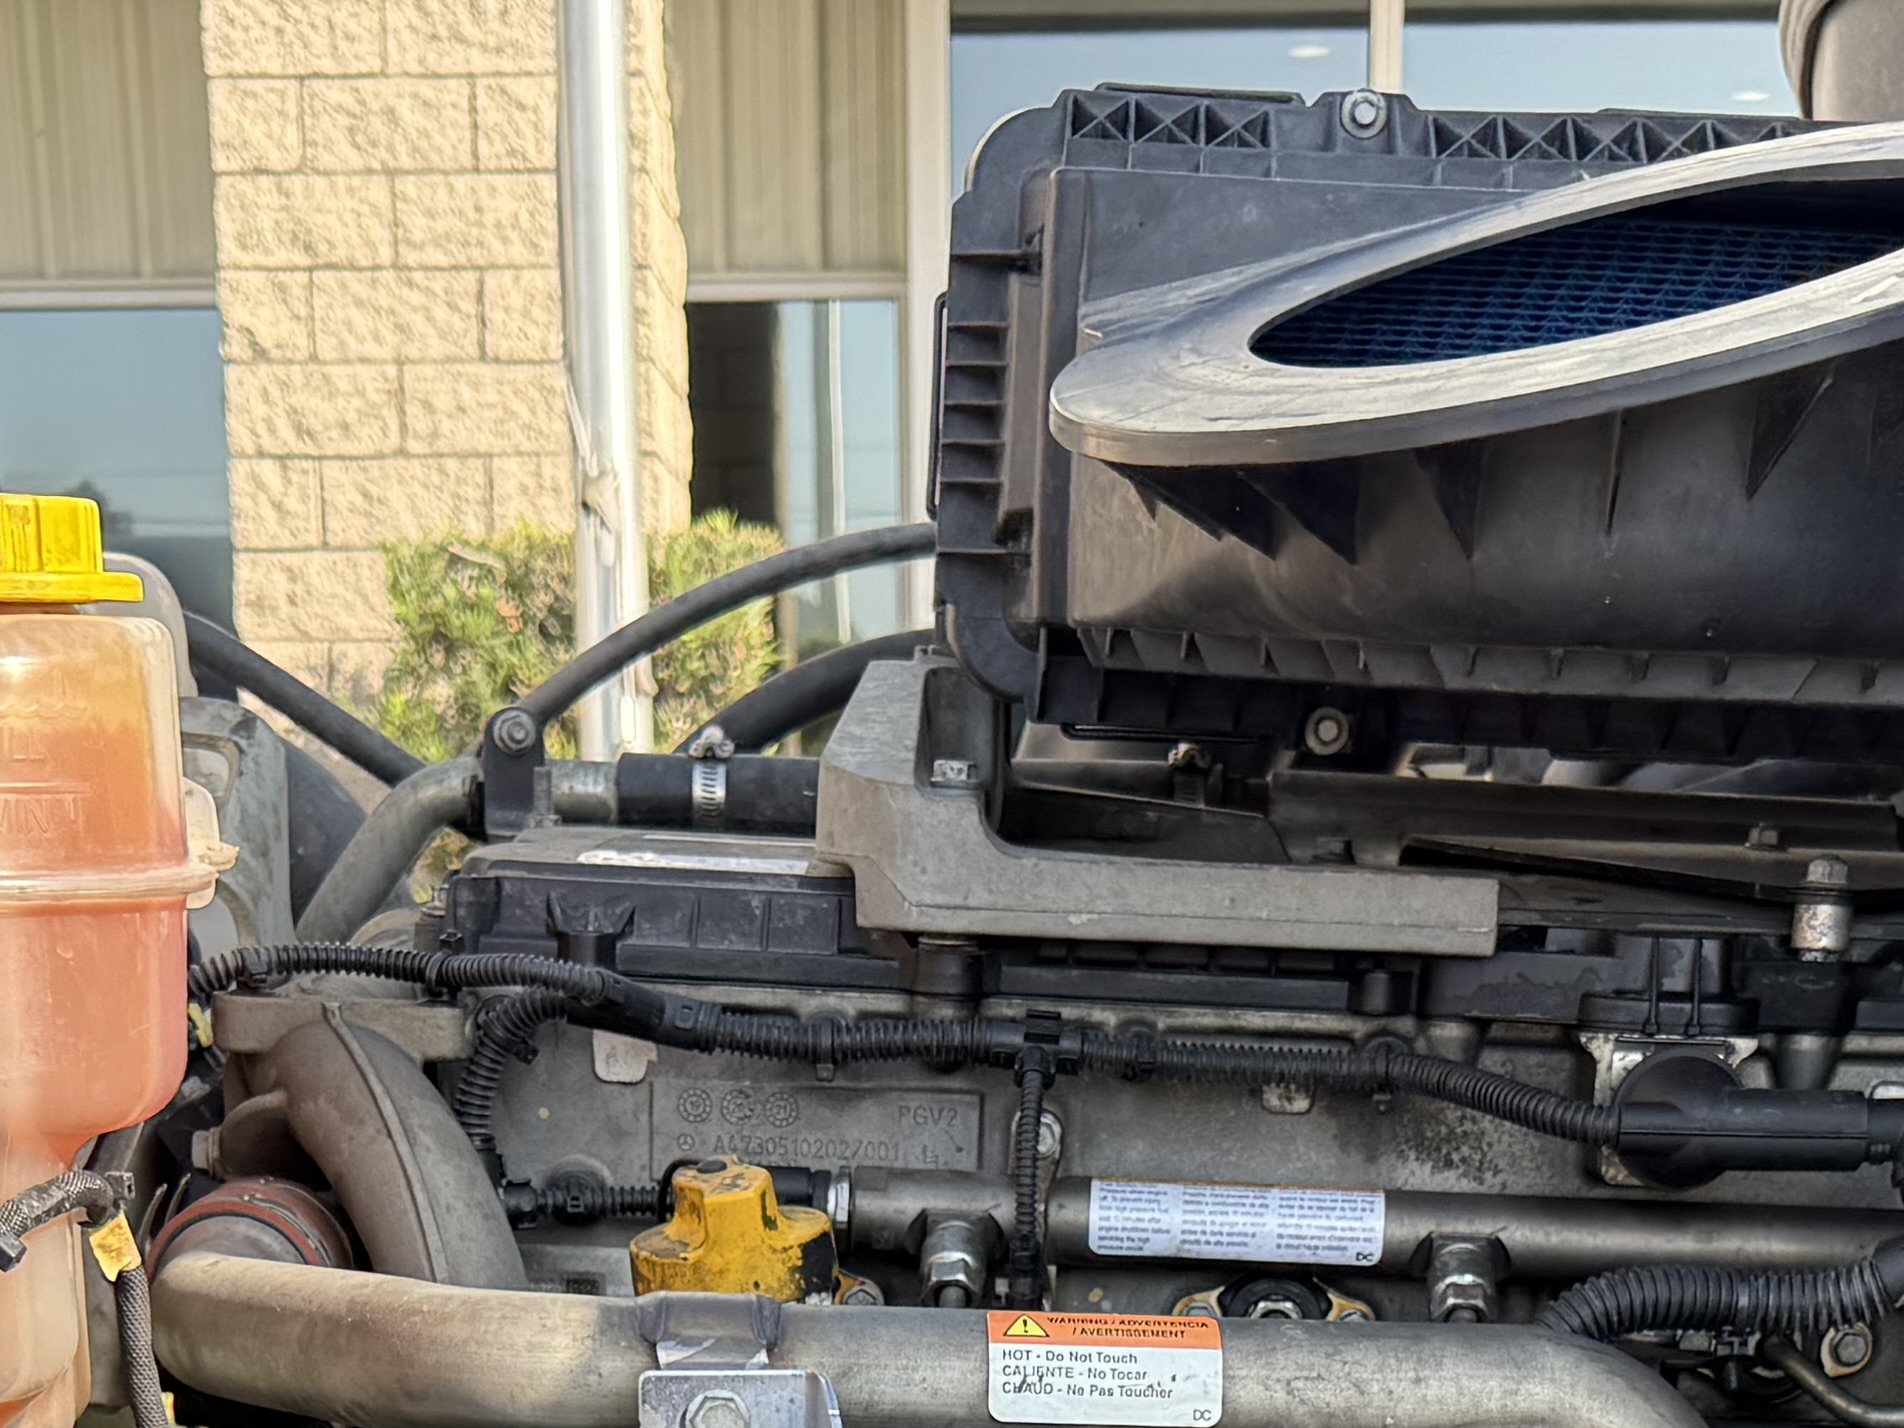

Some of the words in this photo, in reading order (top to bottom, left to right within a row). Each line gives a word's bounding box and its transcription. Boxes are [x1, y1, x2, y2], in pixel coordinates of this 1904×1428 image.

[896, 1105, 959, 1127] PGV2
[1047, 1316, 1109, 1326] WARNING
[1080, 1327, 1186, 1338] AVERTISSEMENT
[1002, 1349, 1032, 1361] HOT
[1045, 1350, 1064, 1362] Do
[1069, 1351, 1093, 1363] Not
[1097, 1352, 1138, 1364] Touch
[1002, 1365, 1074, 1379] CALIENTE
[1087, 1368, 1106, 1380] No
[1111, 1368, 1147, 1380] Tocar
[1089, 1385, 1114, 1397] Pas
[1118, 1386, 1174, 1399] Toucher
[1193, 1409, 1212, 1421] DC
